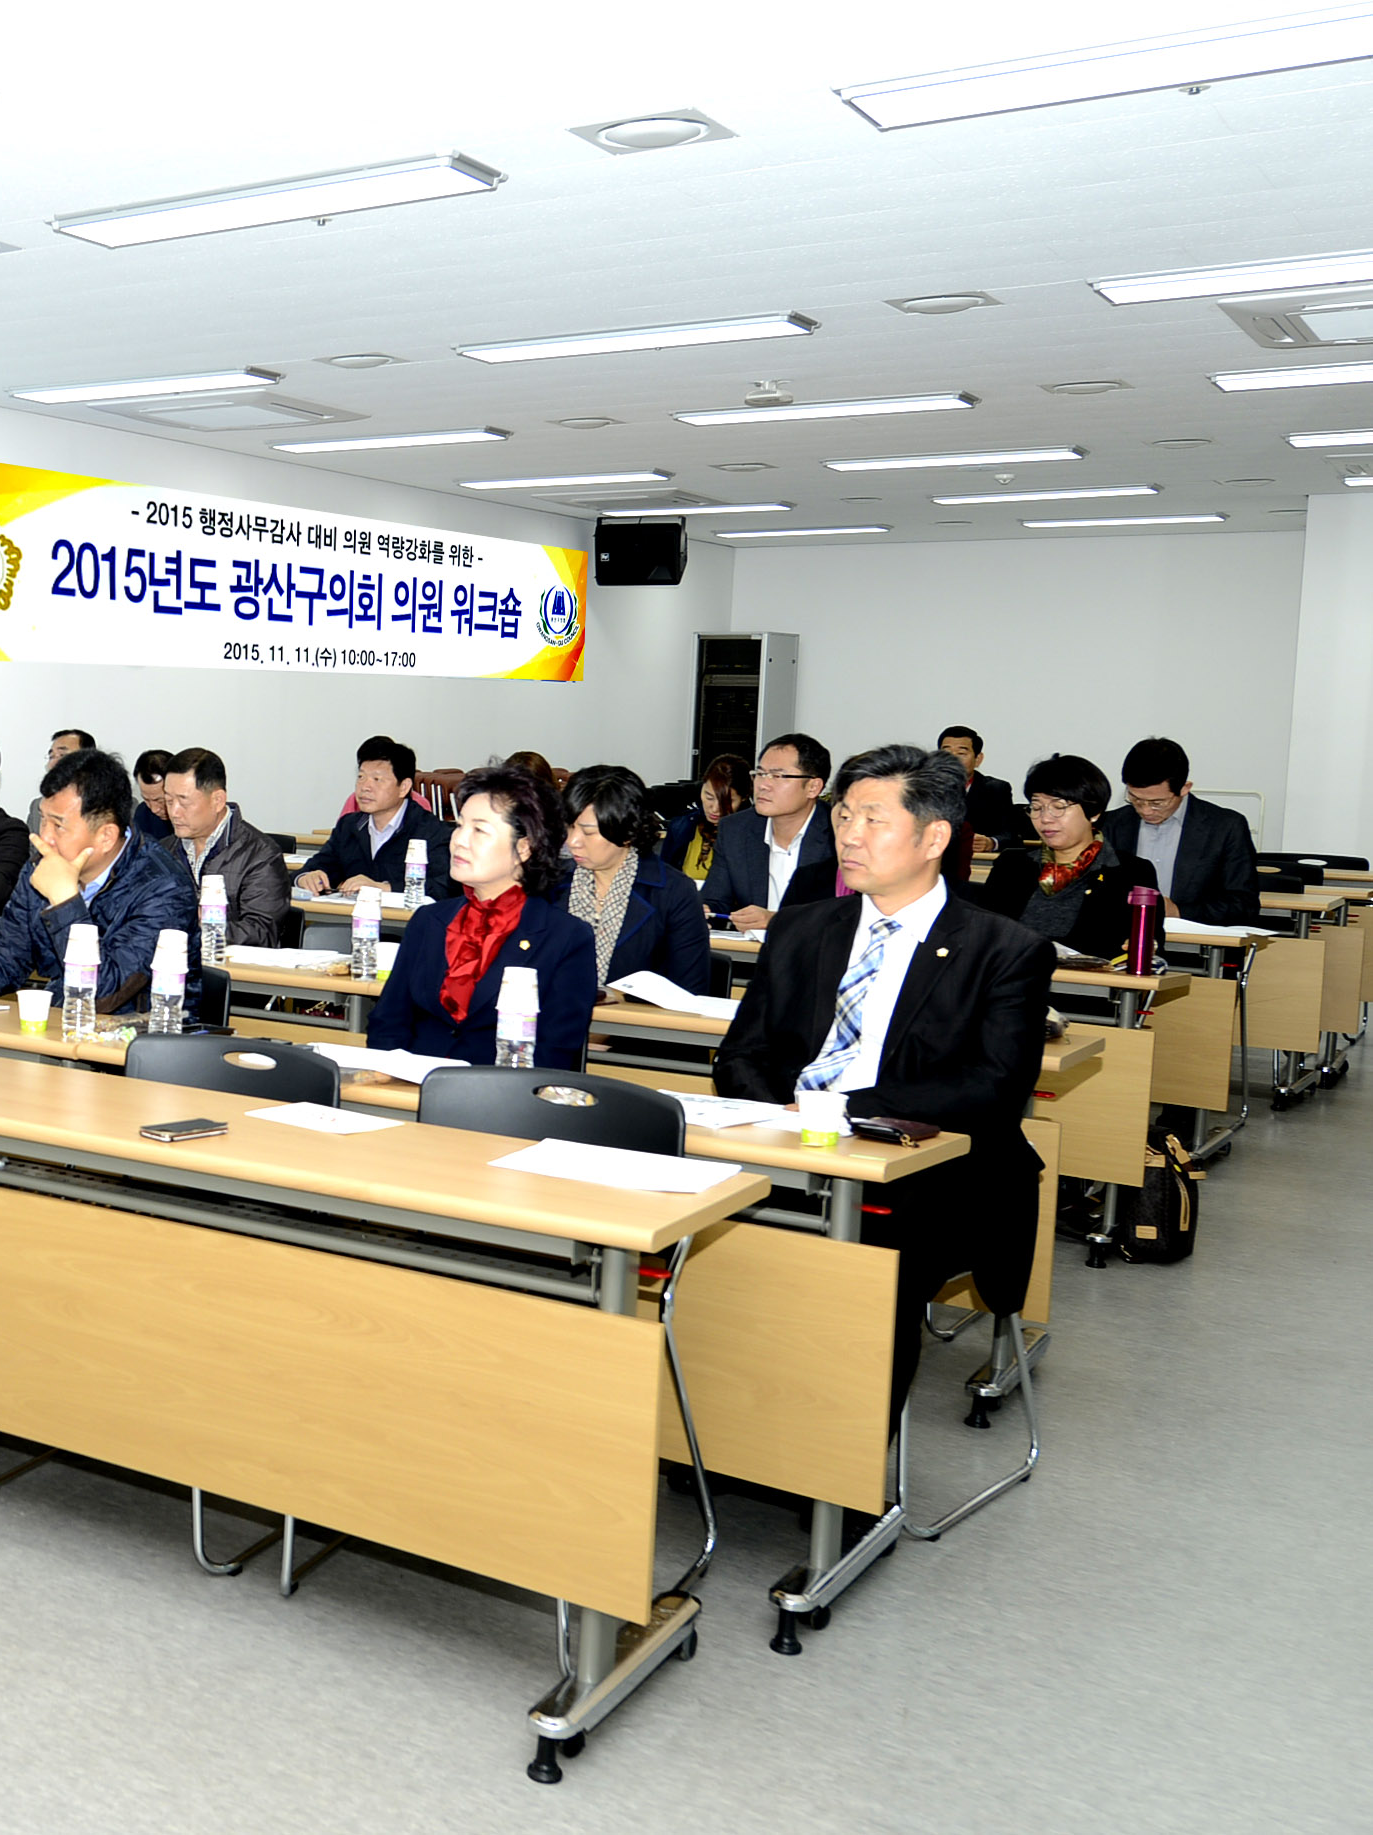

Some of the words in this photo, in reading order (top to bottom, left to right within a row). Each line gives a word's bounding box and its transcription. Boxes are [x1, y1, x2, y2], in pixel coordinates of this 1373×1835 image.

[146, 501, 193, 529] 2015
[199, 508, 302, 547] 행정사무감사
[307, 524, 337, 551] 대비
[343, 529, 371, 555] 의원
[377, 534, 445, 565] 역량강화를
[448, 544, 474, 568] 위한
[51, 539, 221, 615] 2015년도
[229, 559, 383, 631] 광산구의회
[391, 577, 443, 633] 의원
[450, 583, 522, 639] 워크숍
[223, 642, 264, 664] 2015.
[269, 646, 290, 665] 11.
[341, 649, 416, 668] 10:00~17:00
